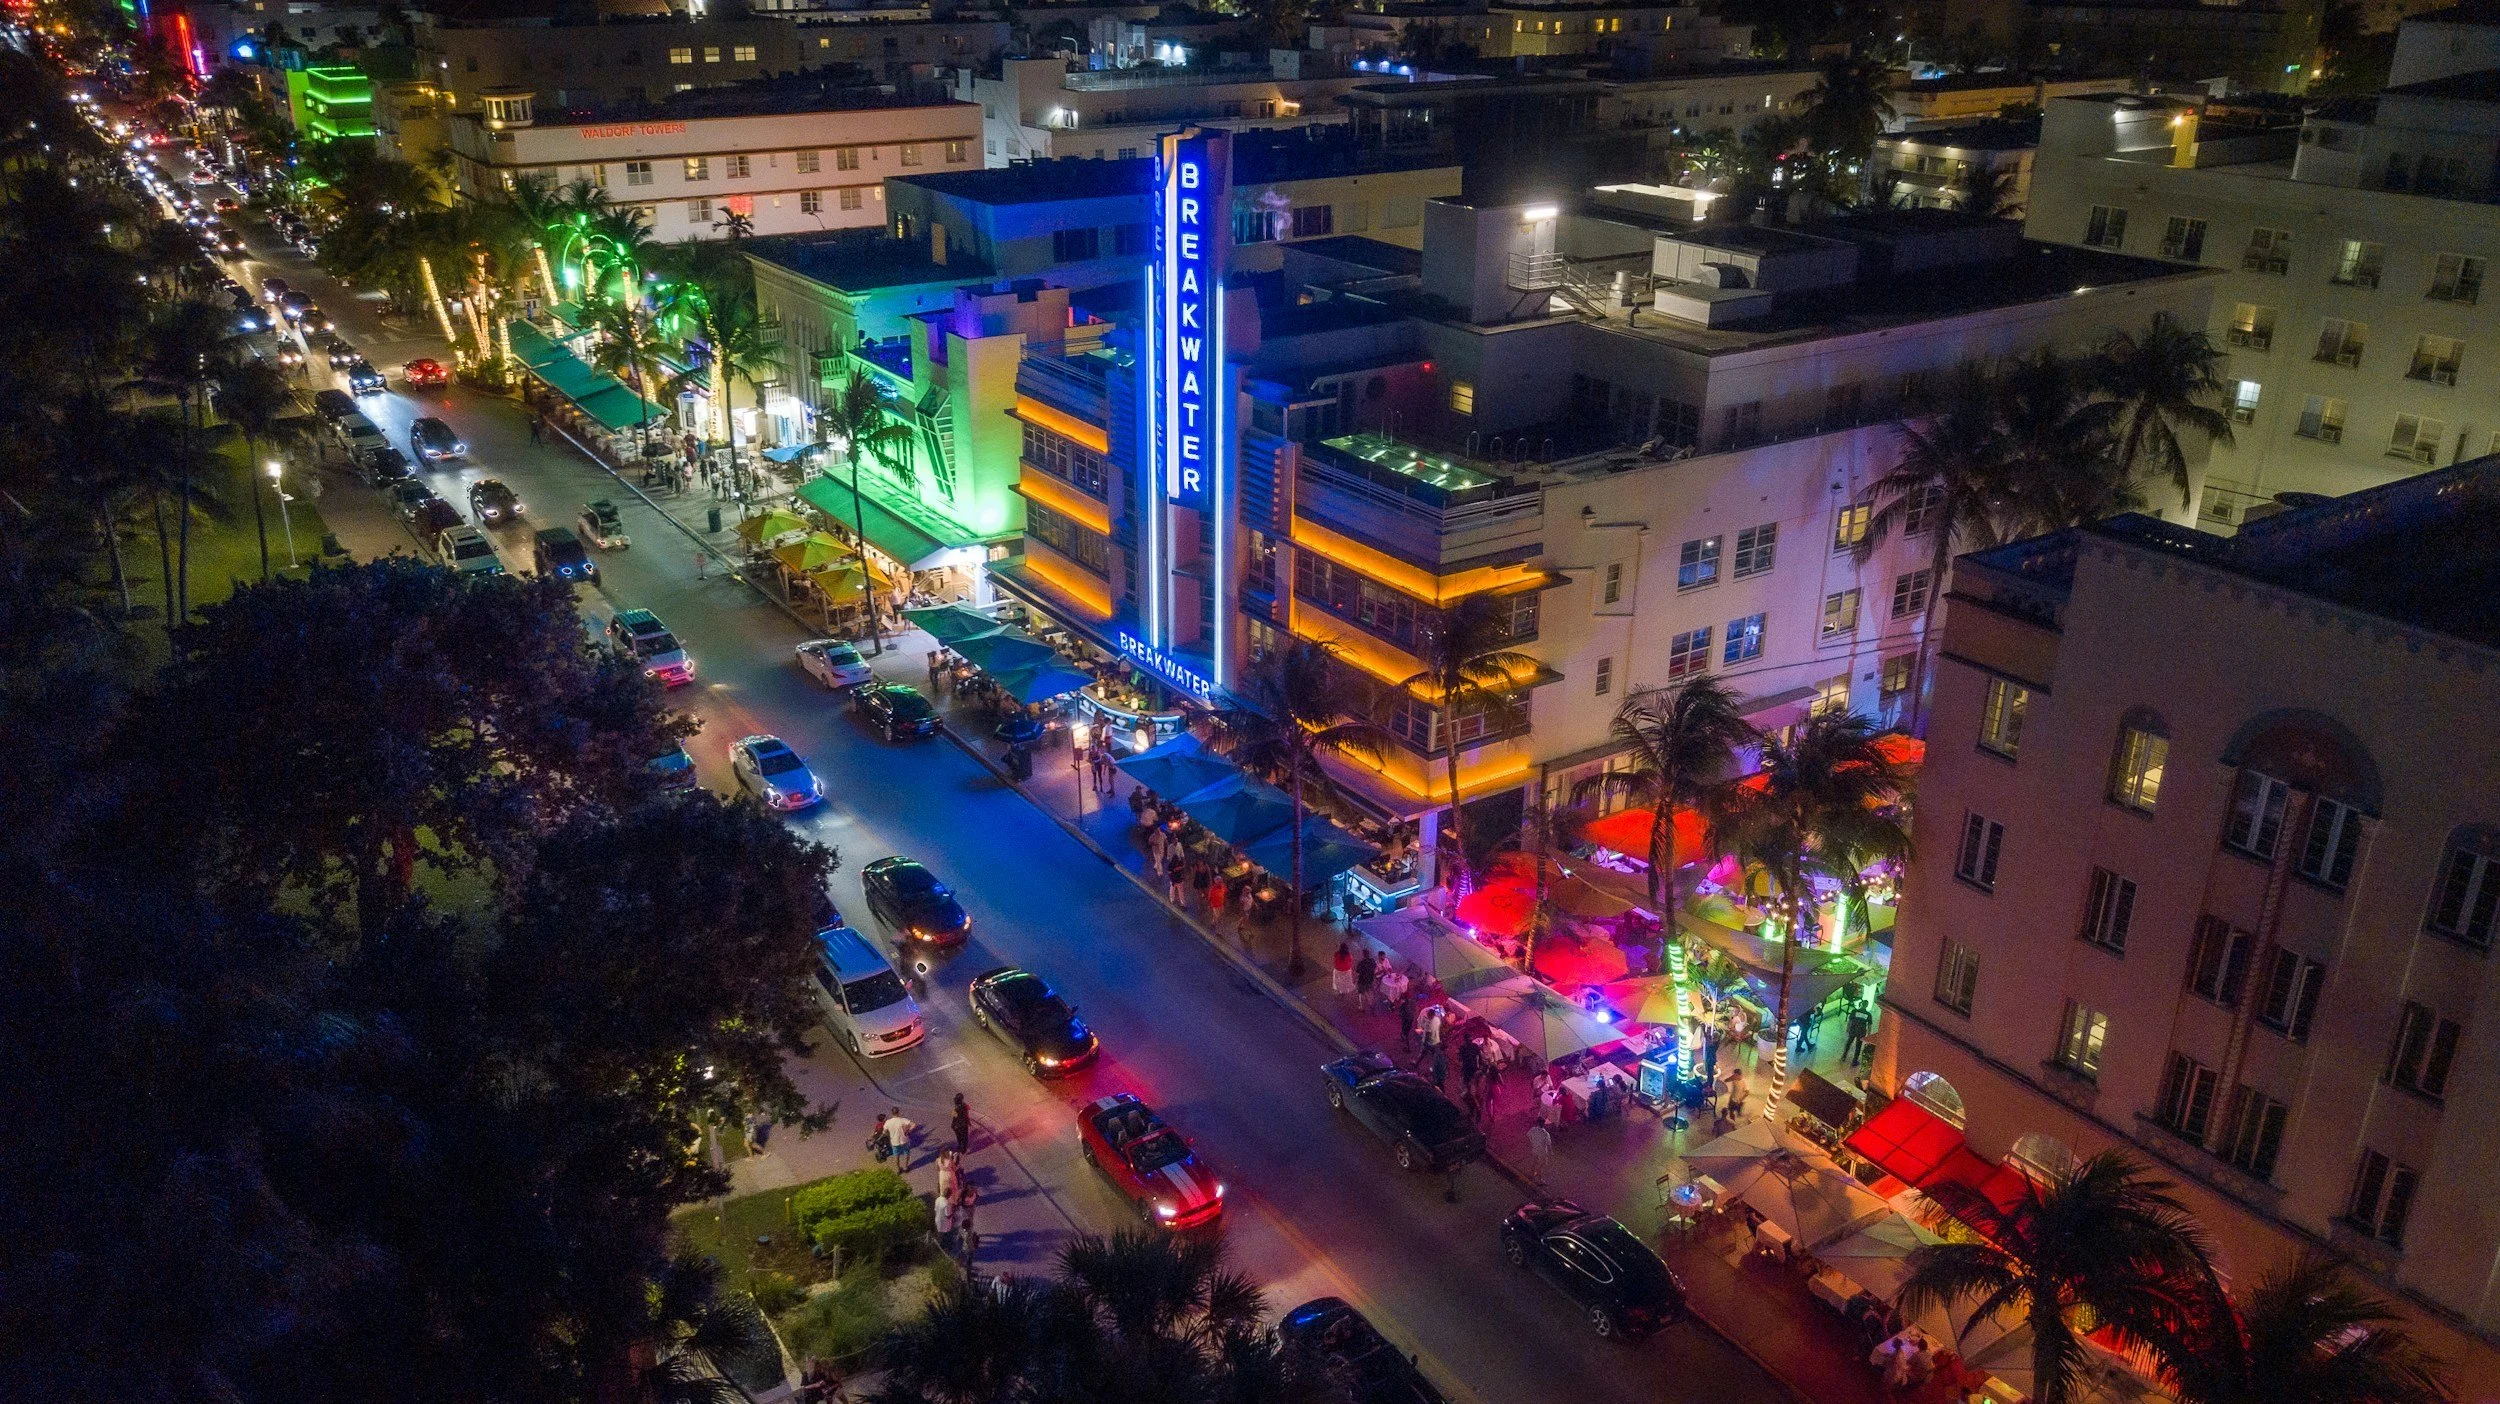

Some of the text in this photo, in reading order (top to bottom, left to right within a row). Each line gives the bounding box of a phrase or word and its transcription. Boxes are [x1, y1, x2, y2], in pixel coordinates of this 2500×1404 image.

[581, 123, 686, 139] WALDORF TOWERS
[1180, 162, 1201, 492] BREAKWATER
[1120, 631, 1210, 700] BREAKWATER
